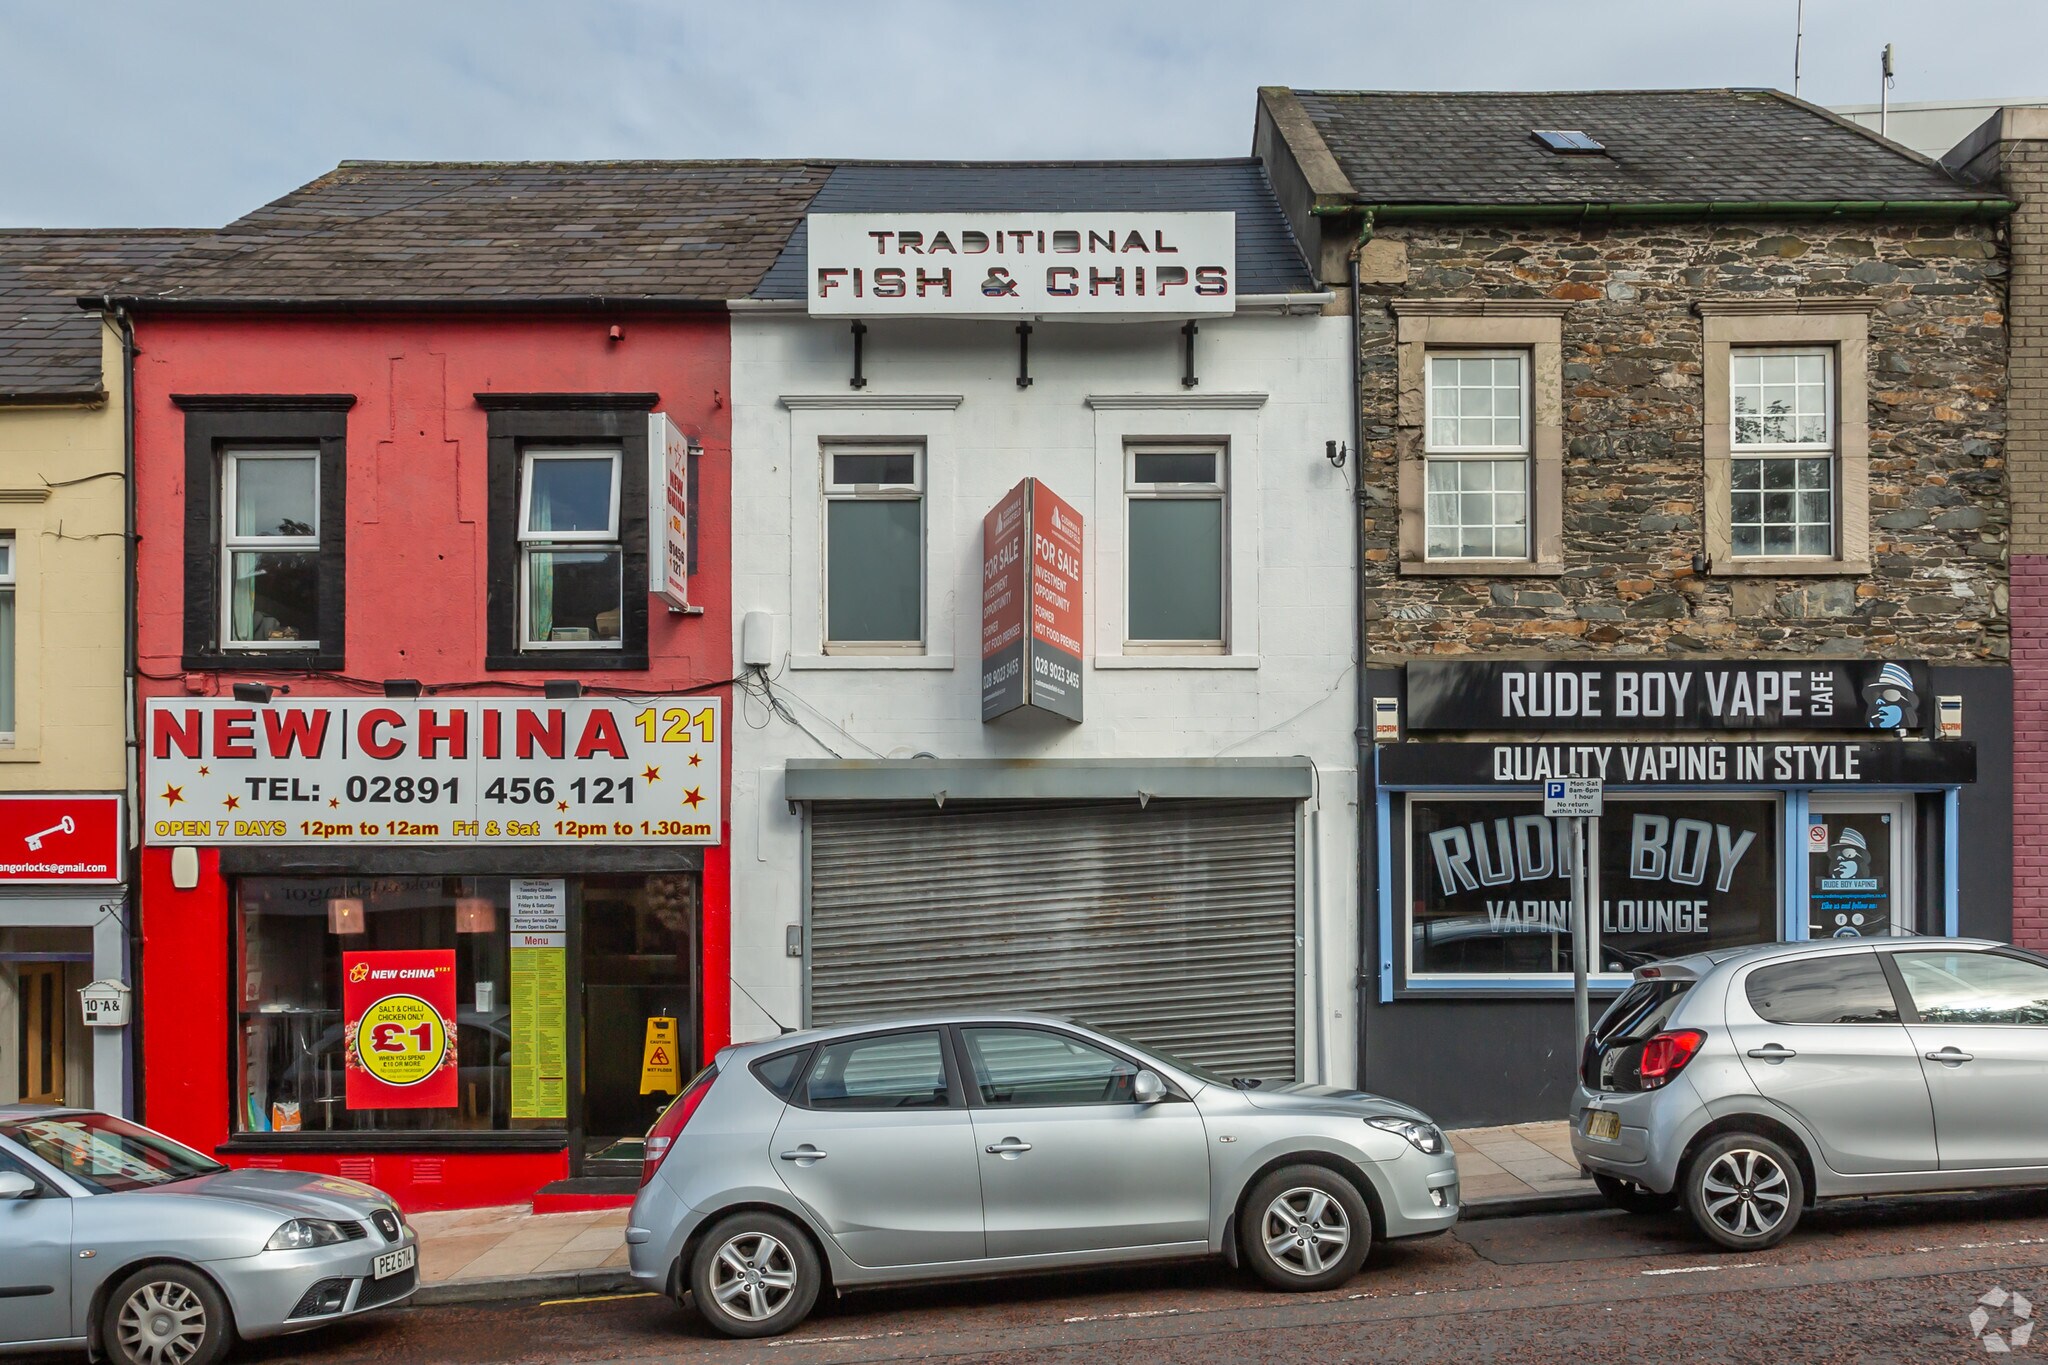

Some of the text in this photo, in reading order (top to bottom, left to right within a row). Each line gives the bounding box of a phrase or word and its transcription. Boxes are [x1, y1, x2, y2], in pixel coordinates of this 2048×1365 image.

[868, 230, 1178, 254] TRADITIONAL
[818, 266, 1228, 298] FISH & CHIPS
[669, 469, 684, 497] NEW
[667, 486, 686, 519] CHINA
[984, 555, 998, 583] FOR
[1000, 536, 1019, 570] SALE
[1035, 533, 1055, 566] FOR
[1057, 548, 1079, 581] SALE
[984, 574, 1008, 602] INVESTMENT
[1035, 564, 1067, 593] INVESTMENT
[984, 590, 1012, 619] OPPORTUNITY
[1034, 583, 1070, 613] OPPORTUNITY
[1035, 604, 1055, 624] FORMER
[983, 620, 998, 638] FORMER
[991, 635, 1002, 649] FOOD
[1034, 622, 1080, 653] HOT FOOD PREMISES
[1034, 656, 1080, 689] 028 9023 3455
[1502, 671, 1802, 717] RUDE BOY VAPE
[1811, 671, 1833, 716] CAFE
[153, 707, 715, 760] NEW CHINA 121
[1376, 724, 1397, 732] SCAN
[1941, 722, 1961, 730] SCAN
[1494, 746, 1860, 780] QUALITY VAPING IN STYLE
[245, 776, 634, 804] TEL: 02891 456 121
[1551, 784, 1561, 796] P
[154, 821, 711, 839] OPEN 7 DAYS 12pm to 12am Fri & Sat 12pm to 1.30am
[1630, 813, 1757, 892] BOY
[1603, 900, 1708, 932] LOUNGE
[525, 936, 548, 945] Menu
[371, 970, 397, 979] NEW
[400, 969, 435, 978] CHINA
[85, 1000, 120, 1011] 10 A &
[371, 1022, 432, 1052] £1
[380, 1254, 396, 1275] PEZ
